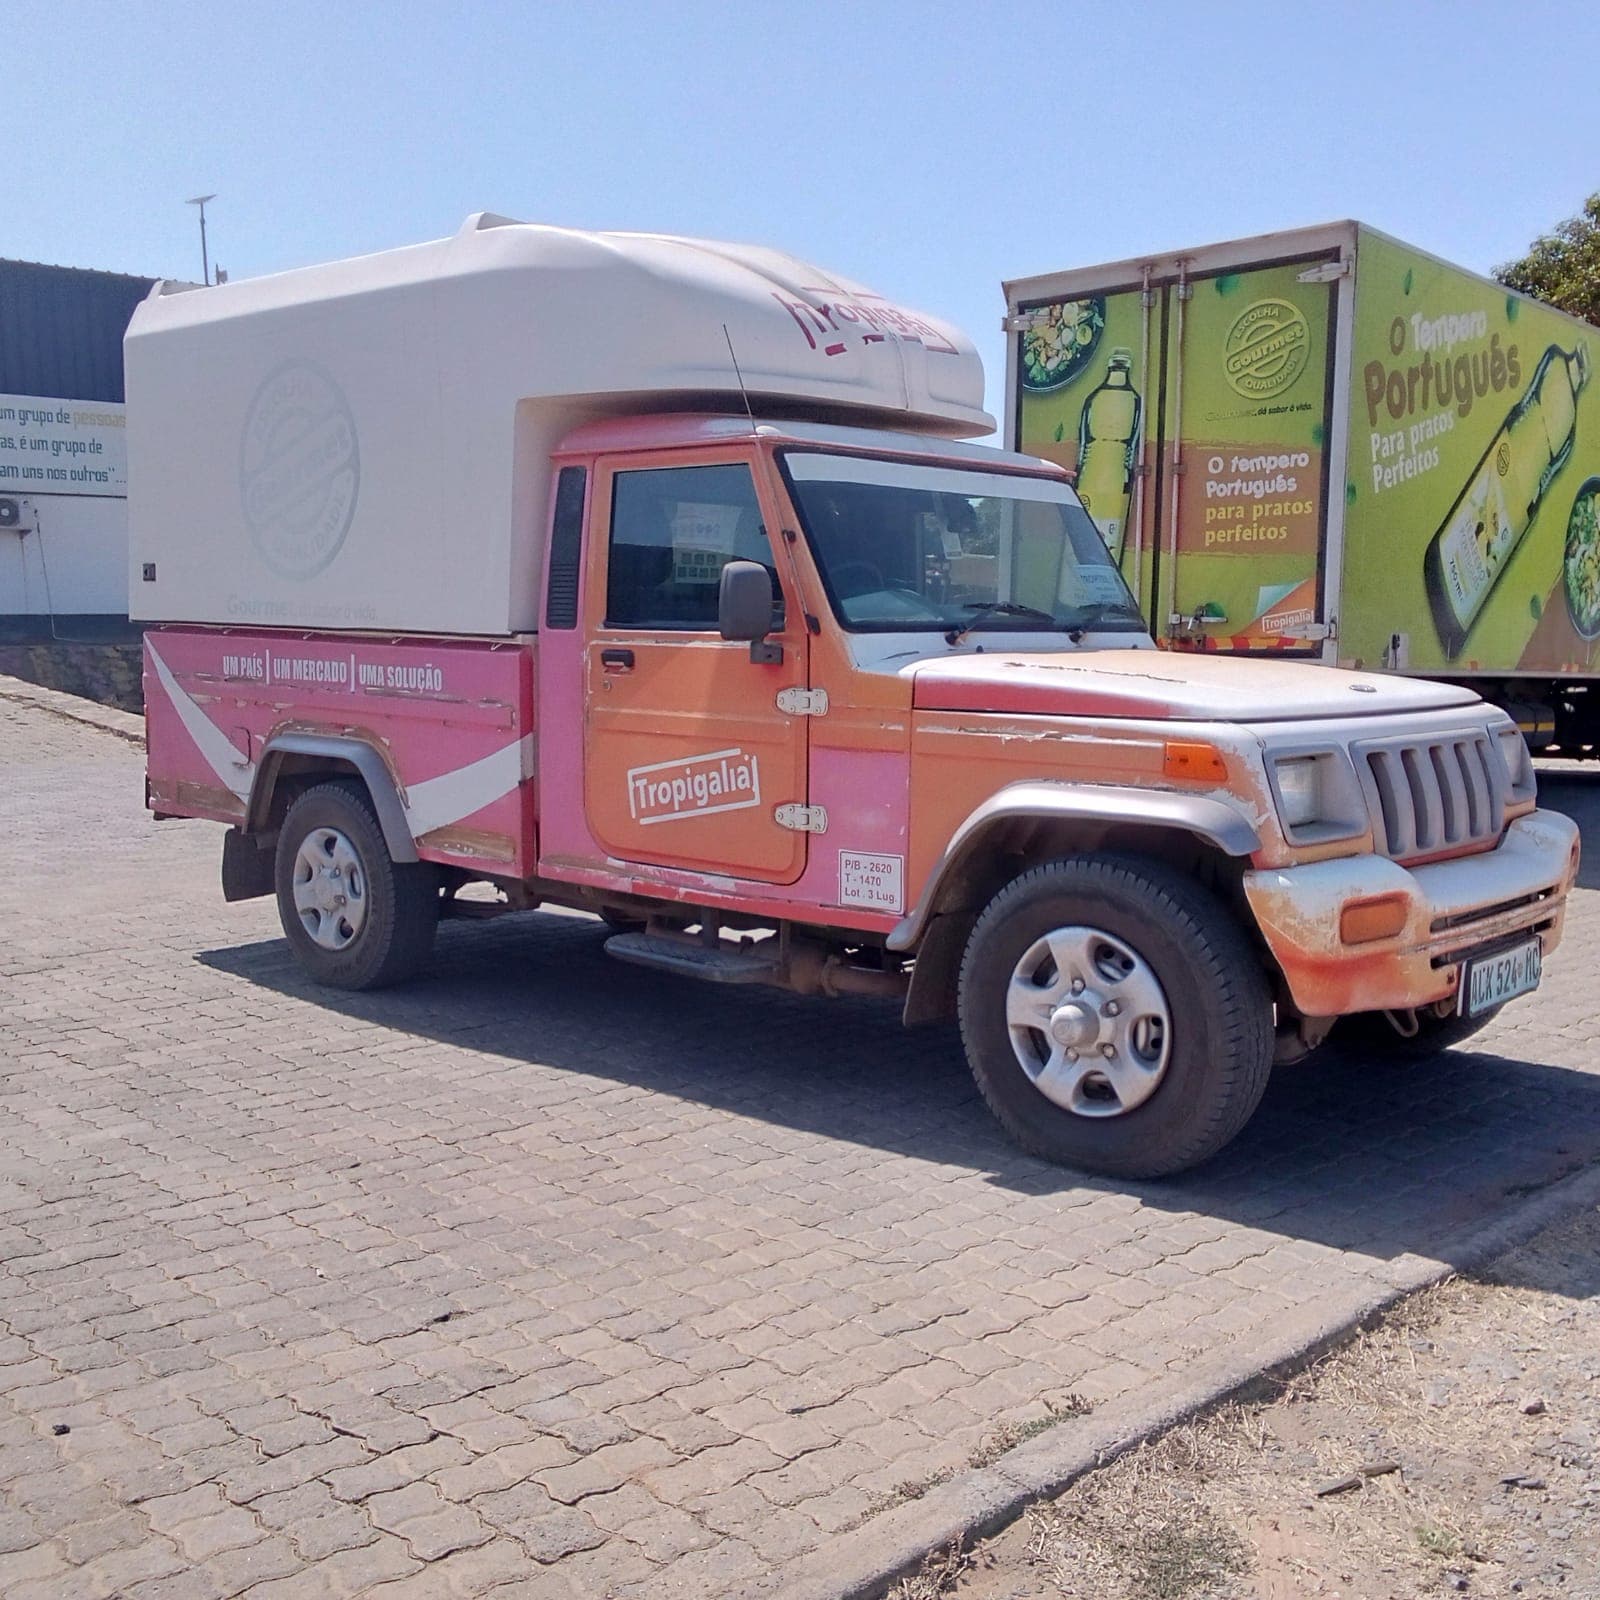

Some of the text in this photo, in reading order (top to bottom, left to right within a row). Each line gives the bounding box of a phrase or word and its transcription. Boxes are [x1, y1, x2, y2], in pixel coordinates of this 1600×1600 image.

[1390, 309, 1487, 356] O Tempero
[1228, 325, 1304, 373] Gourmet
[1364, 332, 1521, 427] Português
[18, 410, 54, 427] grupo
[56, 408, 70, 424] de
[73, 411, 126, 429] pessoas
[0, 435, 103, 457] as, é um grupo de
[1370, 409, 1454, 462] Para pratos
[22, 467, 44, 479] uns
[47, 468, 67, 480] nos
[1208, 452, 1310, 474] O tempero
[1372, 445, 1440, 493] Perfeitos
[1206, 473, 1298, 499] Português
[1205, 499, 1313, 525] para pratos
[1204, 522, 1288, 547] perfeitos
[1265, 610, 1311, 631] Tropigalia
[223, 652, 443, 693] UM PAÍS UM MERCADO UMA SOLUÇÃO
[633, 759, 752, 811] Tropigalia
[845, 859, 861, 871] P/B
[869, 862, 892, 874] 2620
[845, 873, 851, 883] T
[860, 875, 882, 887] 1470
[868, 889, 874, 899] 3
[1496, 957, 1518, 996] 524
[1525, 946, 1540, 984] MC
